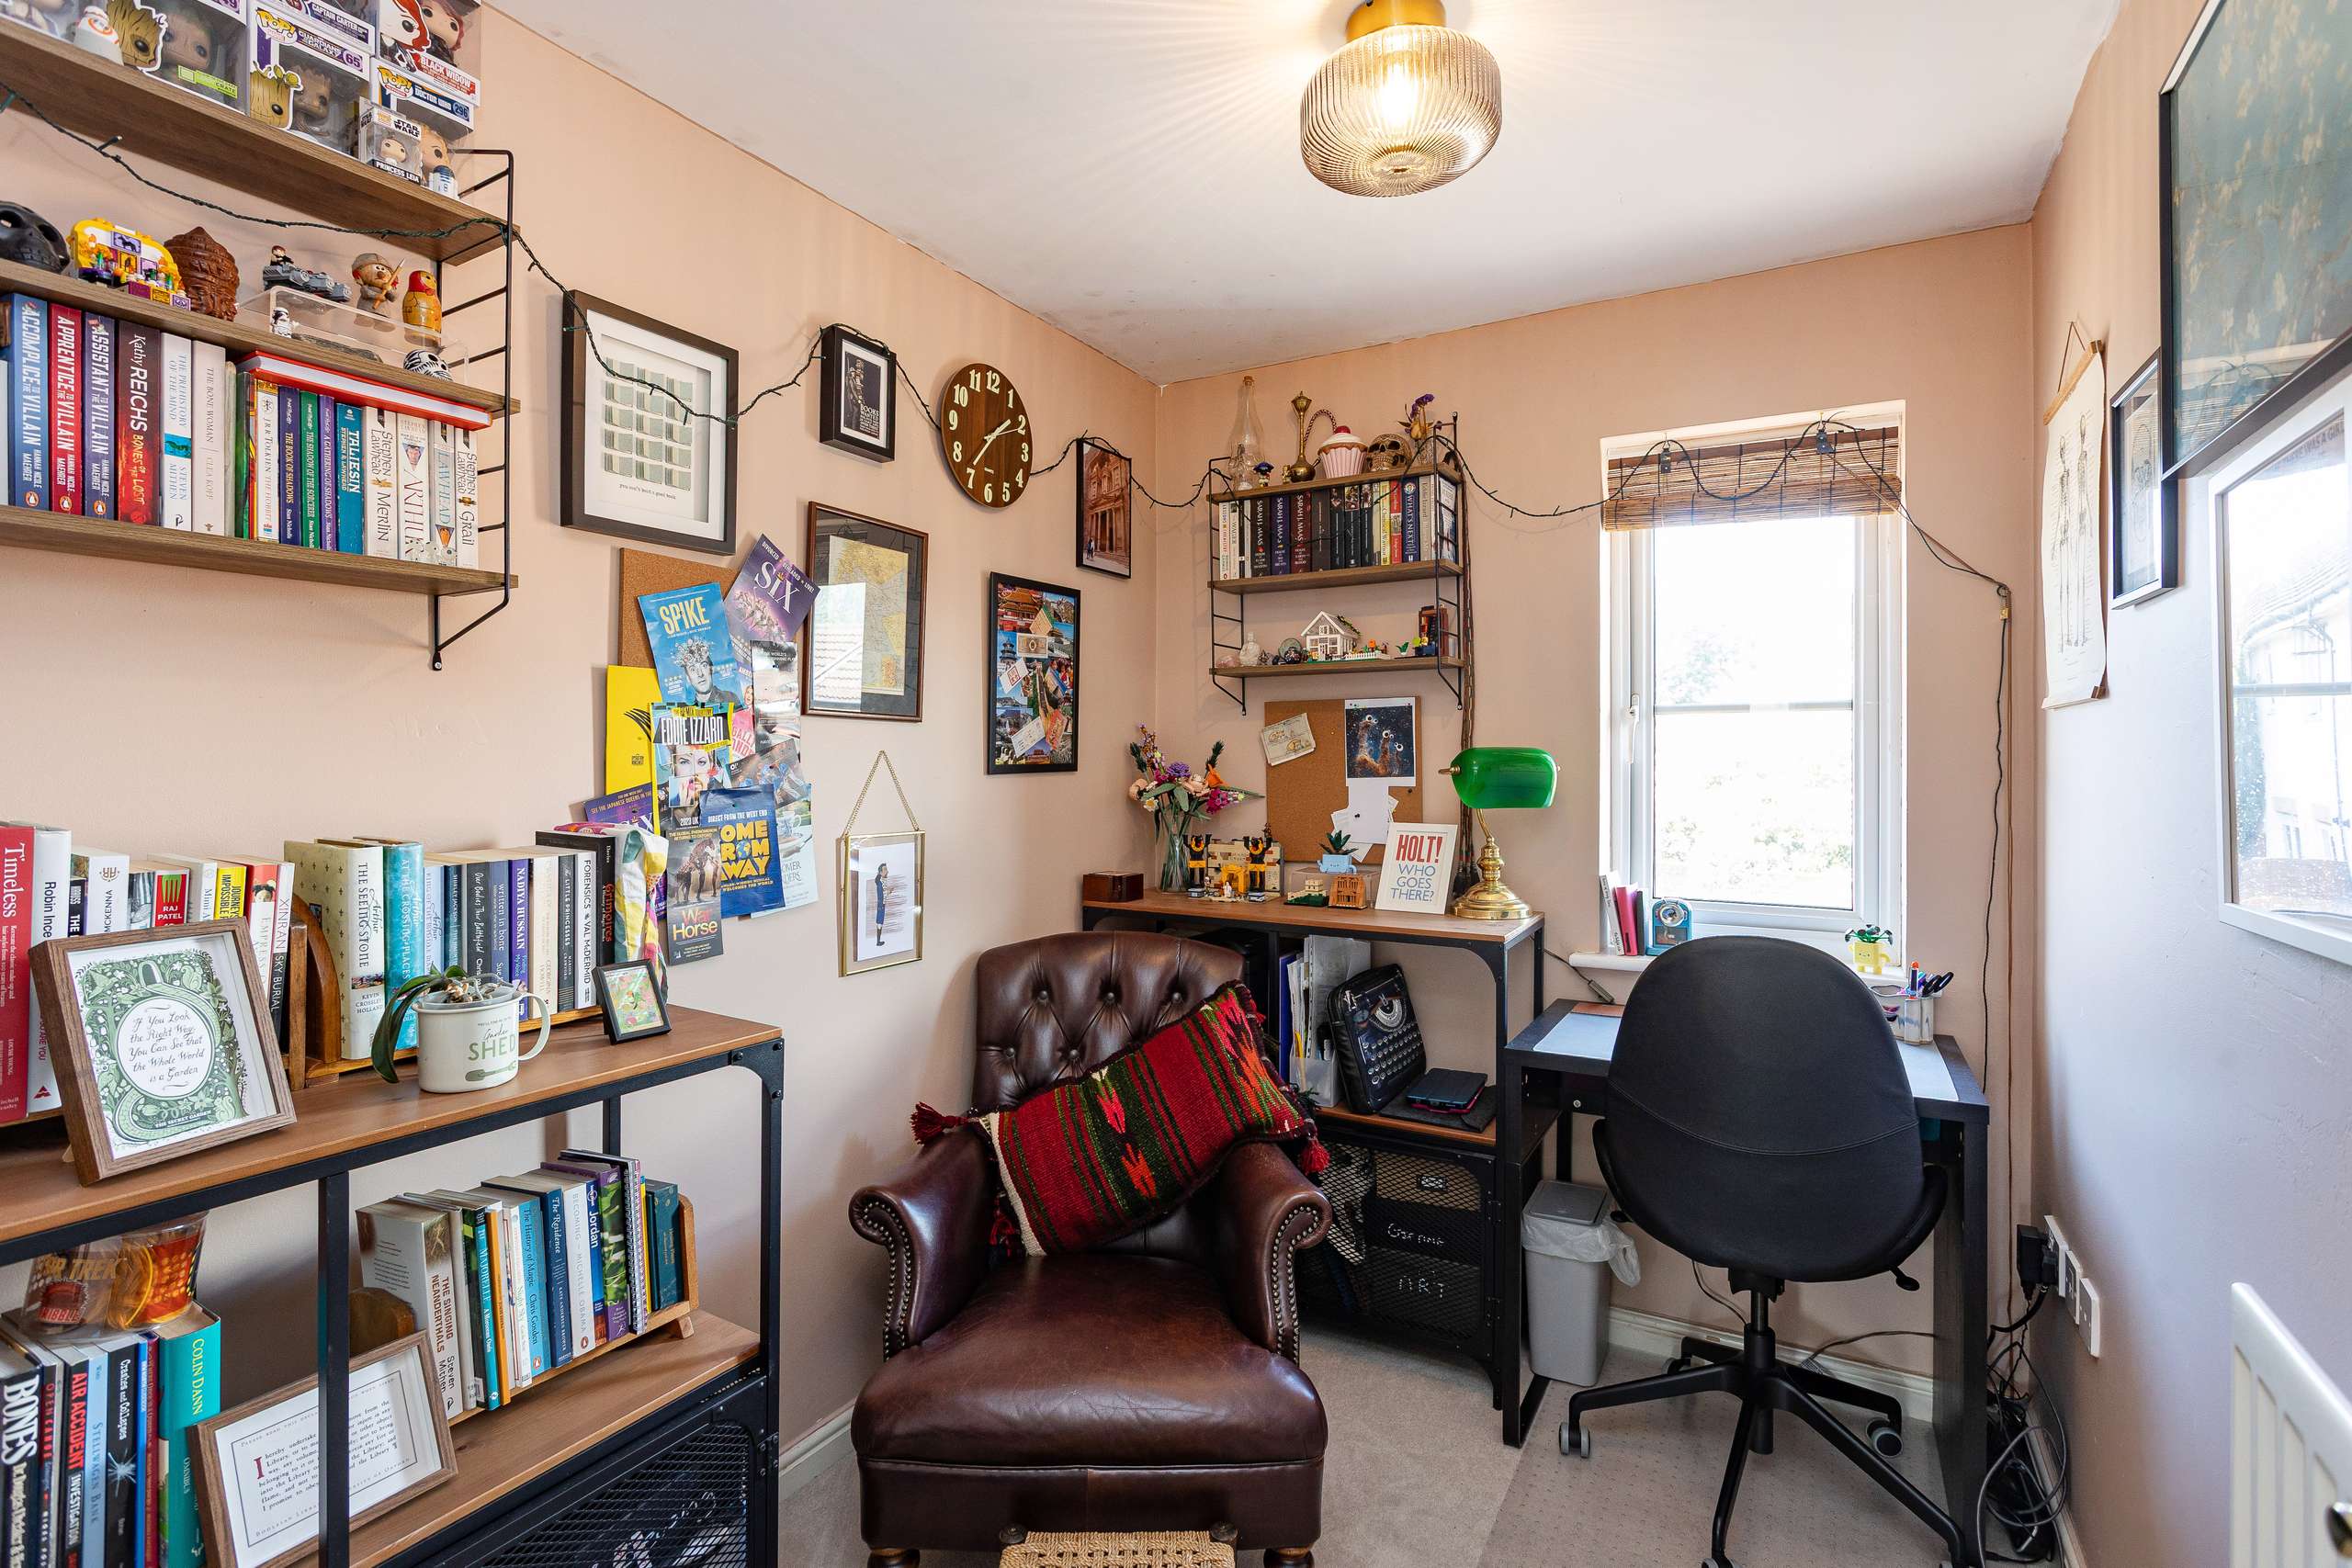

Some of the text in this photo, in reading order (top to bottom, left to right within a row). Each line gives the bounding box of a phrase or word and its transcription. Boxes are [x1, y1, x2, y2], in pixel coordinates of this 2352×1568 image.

[256, 8, 296, 39] POP!
[311, 4, 359, 30] CAPTAIN CARTER
[345, 51, 362, 70] 65
[420, 56, 471, 87] BLACK WIDOW
[377, 66, 413, 92] POP!
[394, 118, 419, 132] STAR
[453, 101, 469, 118] 296
[393, 123, 420, 139] WARS
[375, 161, 420, 184] PRINCESS LEIA
[21, 306, 41, 389] ACCOMPLICE
[57, 315, 75, 390] APPRENTICE
[91, 325, 109, 396] ASSISTANT
[129, 333, 148, 432] Kathy REICHS
[954, 383, 968, 407] 10
[969, 369, 980, 392] 11
[986, 370, 1001, 393] 12
[179, 375, 187, 428] PREHISTORY
[206, 368, 214, 443] THE BONE WOMAN
[860, 405, 879, 416] BOOKS
[1008, 389, 1013, 409] 1
[21, 395, 41, 446] VILLAIN
[56, 400, 75, 452] VILLAIN
[91, 404, 109, 455] VILLAIN
[949, 410, 958, 431] 9
[1017, 414, 1026, 435] 2
[132, 434, 144, 466] BONES
[348, 430, 361, 493] TALIESIN
[381, 432, 393, 477] Stephen
[953, 441, 962, 463] 8
[1021, 442, 1029, 463] 3
[169, 463, 177, 501] MITHEN
[179, 466, 187, 501] STEVEN
[438, 452, 451, 525] LAWHEAD
[466, 453, 478, 496] Stephen
[967, 467, 975, 490] 7
[1015, 468, 1023, 488] 4
[130, 479, 145, 506] LOST
[984, 483, 993, 503] 6
[1001, 482, 1011, 502] 5
[761, 541, 780, 560] DIVORCED
[754, 561, 799, 614] SIX
[659, 596, 710, 635] SPIKE
[661, 716, 688, 746] EDDIE
[690, 716, 724, 745] IZZARD
[720, 820, 768, 842] OME
[720, 838, 770, 862] ROM
[1396, 834, 1443, 863] HOLT!
[2, 842, 26, 919] Timeless
[1396, 876, 1432, 890] GOES
[1398, 863, 1436, 877] WHO
[42, 881, 56, 938] Robin Ince
[104, 888, 113, 932] MCKENNA
[220, 874, 231, 915] IMPOSSIBLE
[231, 885, 242, 919] JOURNEYS
[474, 886, 483, 907] Bodies
[516, 867, 526, 950] NADIYA HUSSAIN
[1391, 887, 1435, 902] THERE?
[358, 862, 369, 968] THE SEEING STONE
[498, 884, 507, 952] written in bone
[583, 859, 592, 985] FORENSICS VAL McDERMID
[605, 883, 615, 942] Grimoires
[682, 908, 710, 926] War
[673, 920, 718, 942] Horse
[271, 898, 290, 1012] XINRAN SKY BURIAL
[356, 1005, 384, 1014] HOLLAND
[361, 992, 380, 1000] KEVIN
[168, 1010, 190, 1023] Look
[130, 1047, 148, 1062] You
[151, 1042, 167, 1054] Can
[133, 1048, 205, 1073] the Whole World
[468, 1034, 515, 1062] SHED
[553, 1213, 561, 1254] Residence
[587, 1210, 599, 1248] Jordan
[479, 1248, 491, 1303] MAJORELLE
[524, 1208, 540, 1346] The History of Magic Chris Gosden
[572, 1193, 588, 1332] BECOMING MICHELLE OBAMA
[431, 1274, 443, 1353] NEANDERTHALS
[441, 1276, 454, 1339] THE SINGING
[192, 1337, 205, 1416] COLIN DANN
[437, 1359, 447, 1393] Mithen
[446, 1355, 456, 1389] Steven
[45, 1382, 54, 1416] OPEN
[117, 1359, 131, 1440] Crashes and Collapses
[1, 1373, 40, 1466] BONES
[68, 1372, 88, 1545] AIR ACCIDENT INVESTIGATION
[254, 1432, 317, 1480] I hereby undertake
